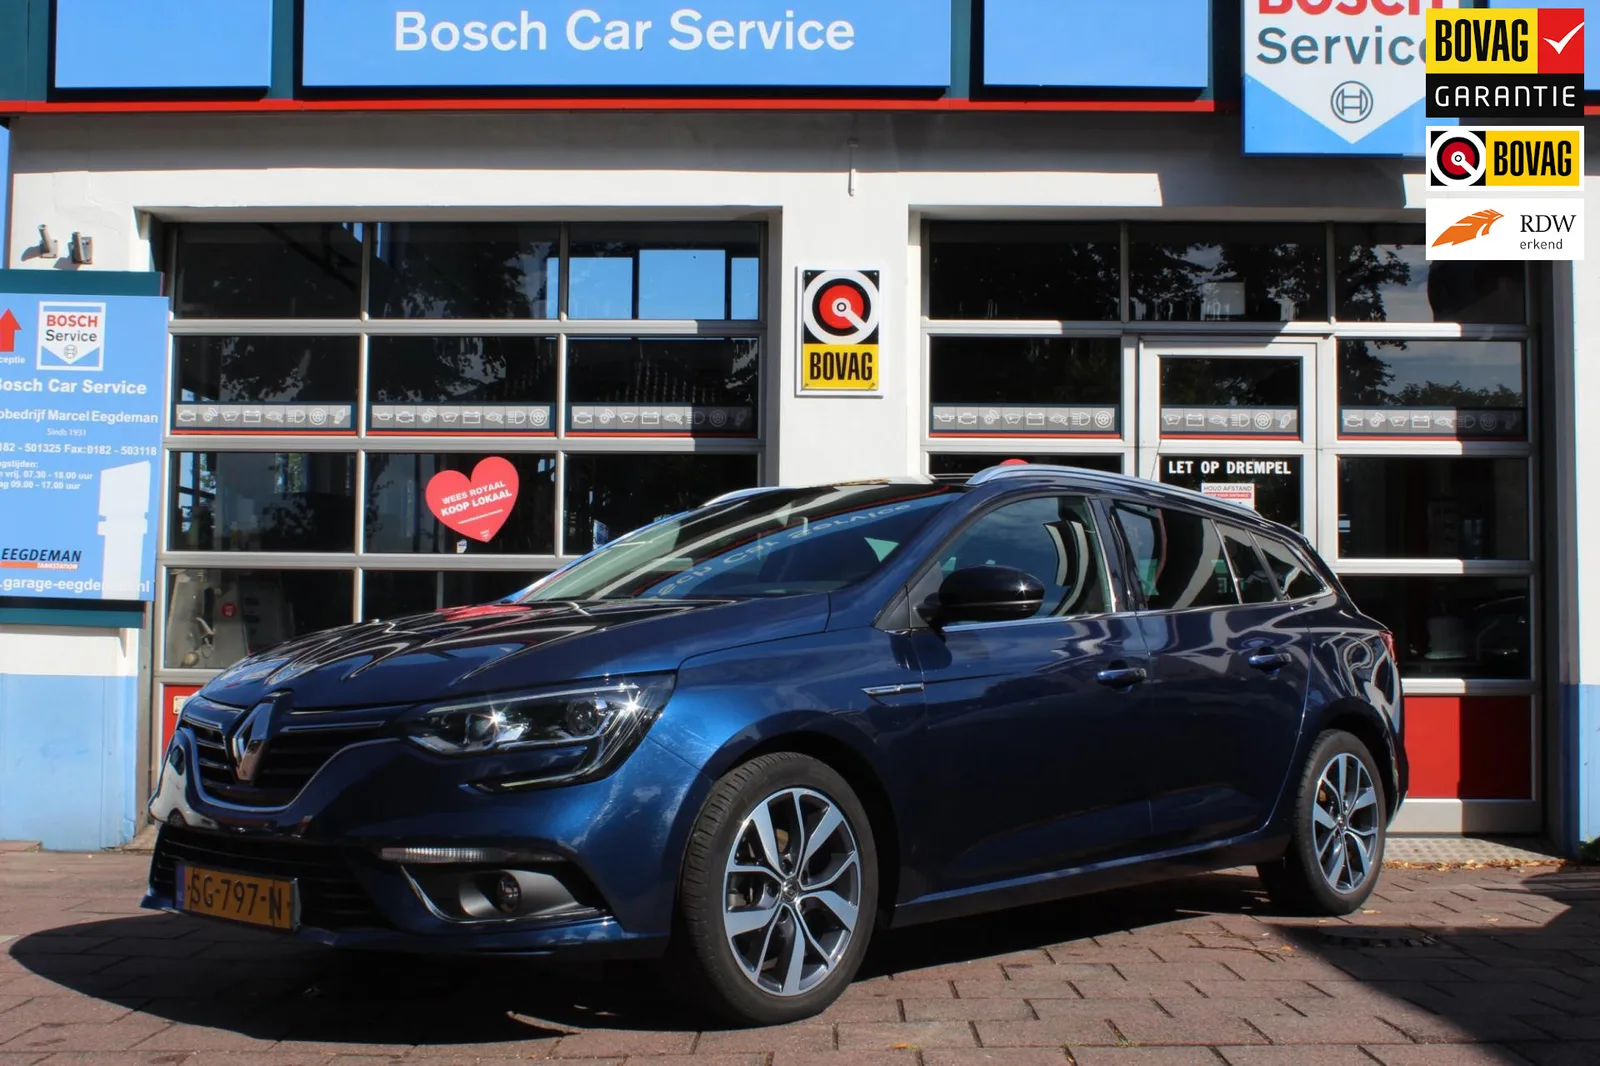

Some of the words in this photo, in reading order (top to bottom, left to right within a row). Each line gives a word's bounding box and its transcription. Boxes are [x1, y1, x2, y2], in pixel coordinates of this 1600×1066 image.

[395, 10, 547, 52] Bosch
[566, 9, 652, 51] Car
[668, 9, 856, 51] Service
[1257, 25, 1426, 66] Servic
[46, 314, 98, 327] BOSCH
[45, 329, 97, 342] Service
[810, 352, 873, 381] BOVAG
[0, 377, 42, 392] osch
[48, 379, 78, 393] Car
[82, 380, 147, 395] Service
[48, 410, 89, 421] Marcel
[92, 411, 159, 425] Eegdeman
[25, 443, 61, 453] 501325
[121, 446, 157, 456] 503118
[1168, 461, 1193, 474] LET
[1200, 461, 1220, 474] OP
[1226, 461, 1292, 475] DREMPEL
[441, 491, 468, 505] WEES
[469, 480, 506, 497] ROYAAL
[440, 501, 470, 517] KOOP
[472, 488, 512, 508] LOKAAL
[1, 548, 82, 562] EEGDEMAN
[190, 871, 283, 921] SG-797-N
